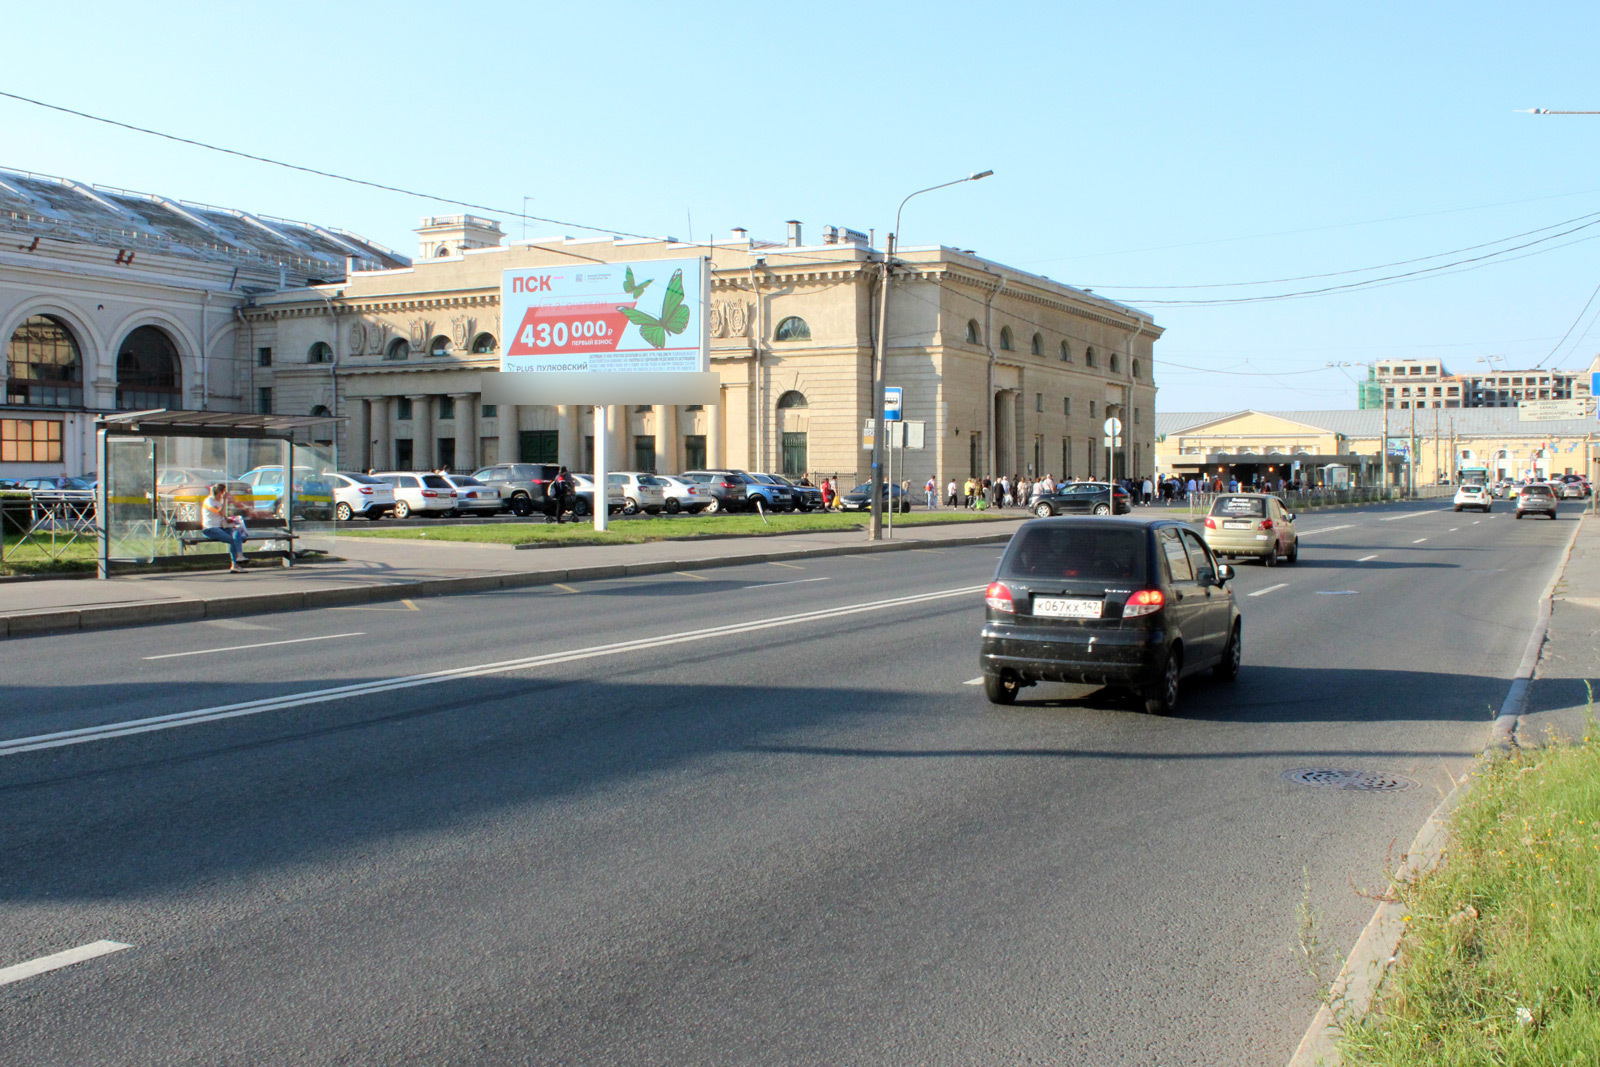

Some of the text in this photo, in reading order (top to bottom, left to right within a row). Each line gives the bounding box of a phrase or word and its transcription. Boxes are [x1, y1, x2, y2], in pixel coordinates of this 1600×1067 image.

[513, 275, 552, 293] ПСК
[521, 322, 569, 348] 430
[571, 320, 607, 338] 000
[516, 362, 588, 373] PLUS ПУЛКОВСКИЙ
